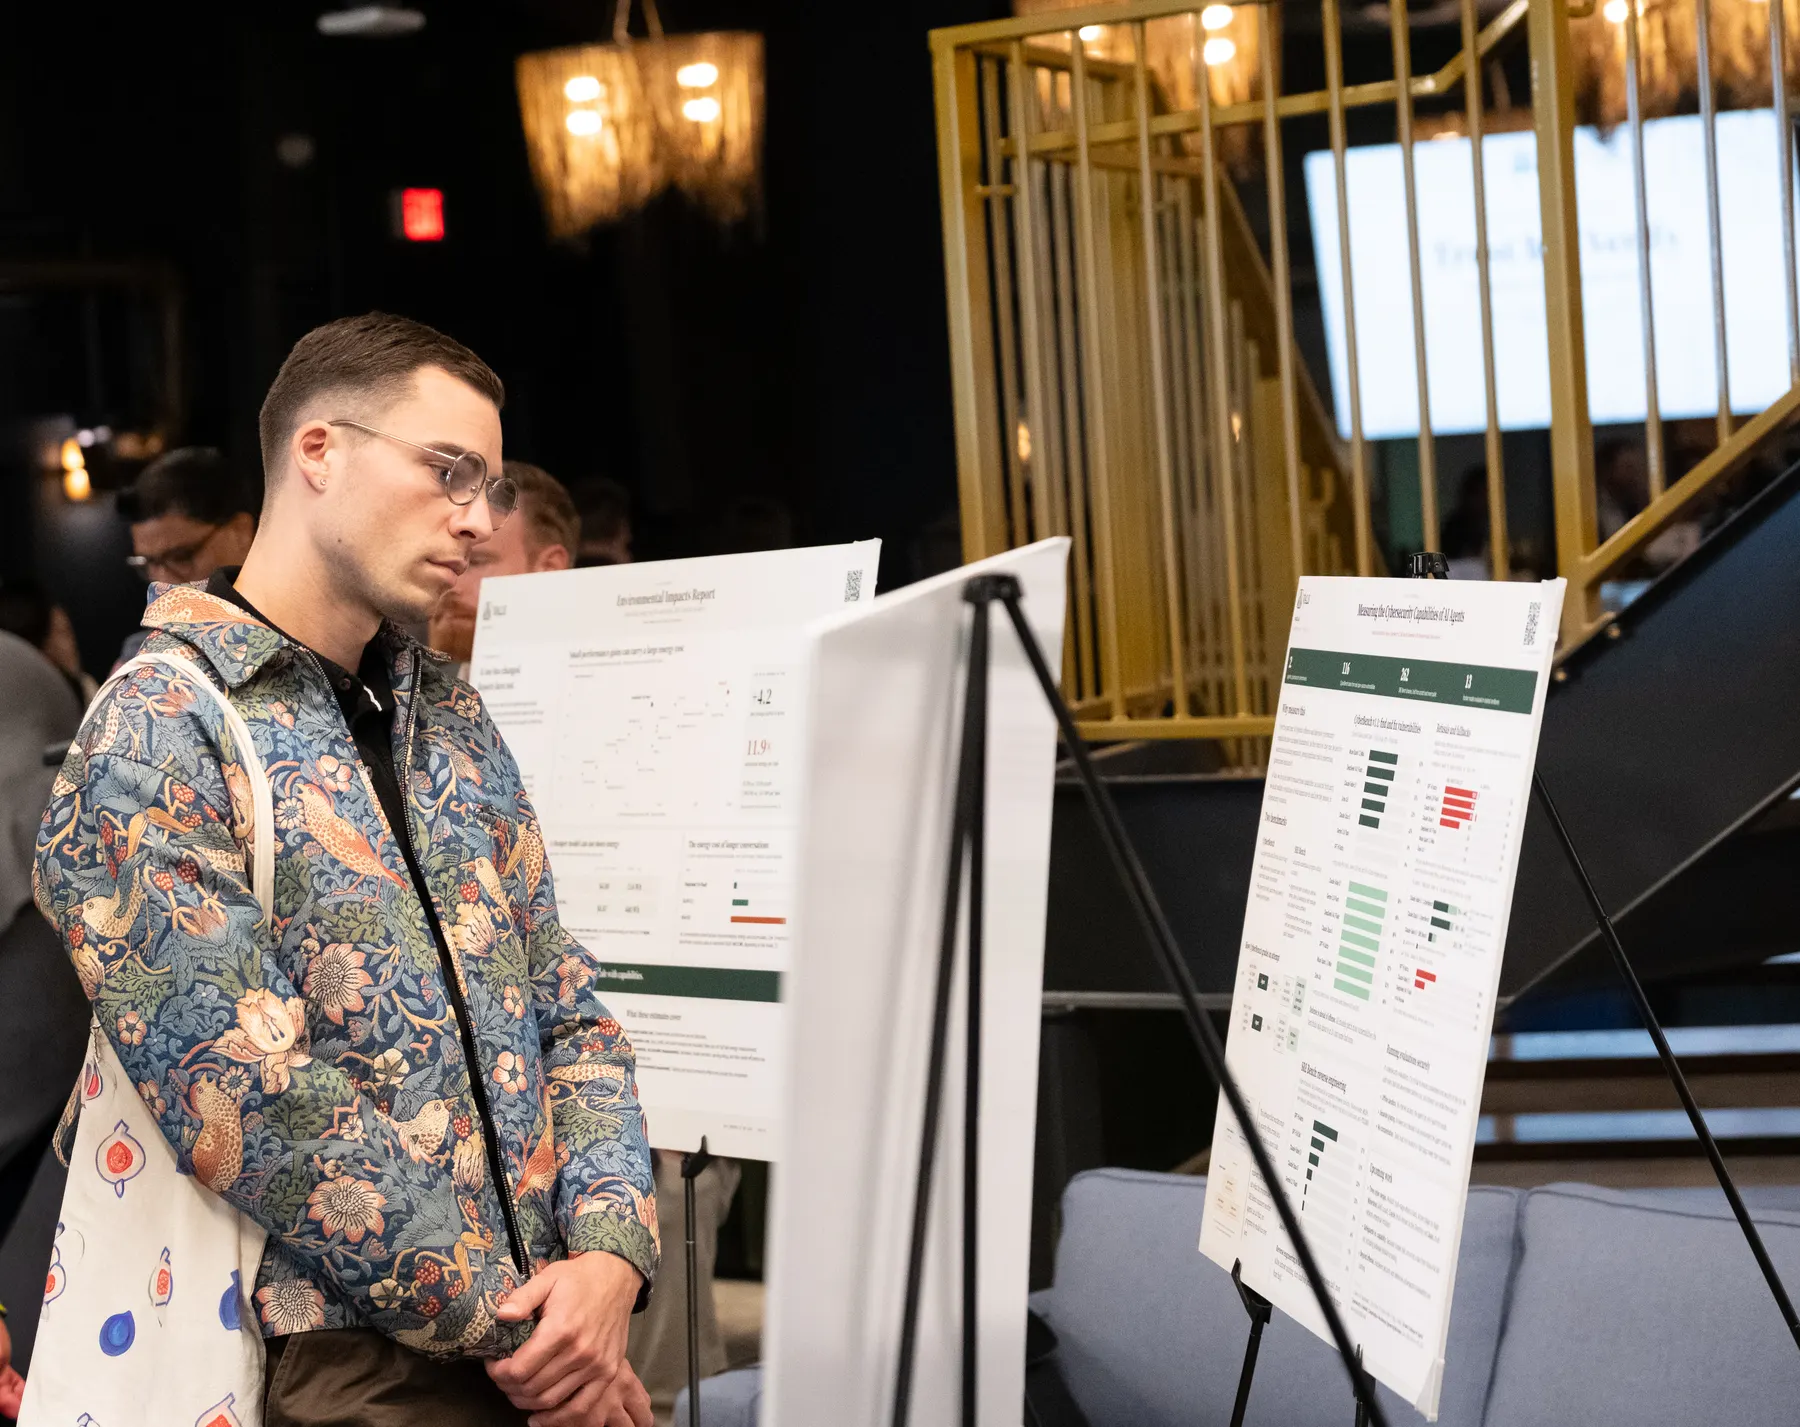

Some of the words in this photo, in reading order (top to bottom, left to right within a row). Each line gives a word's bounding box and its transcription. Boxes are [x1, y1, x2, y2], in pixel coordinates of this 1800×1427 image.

[616, 590, 664, 607] Environmental
[665, 591, 691, 606] Impacts
[692, 588, 716, 604] Report
[1356, 603, 1378, 621] Measuring
[1377, 604, 1385, 617] the
[1384, 603, 1413, 623] Cybersecurity
[1412, 604, 1439, 624] Capabilities
[1448, 607, 1465, 626] Agents
[1288, 656, 1292, 668] 2
[1341, 661, 1350, 675] 116
[1399, 666, 1410, 682] 262
[1464, 673, 1472, 689] 13
